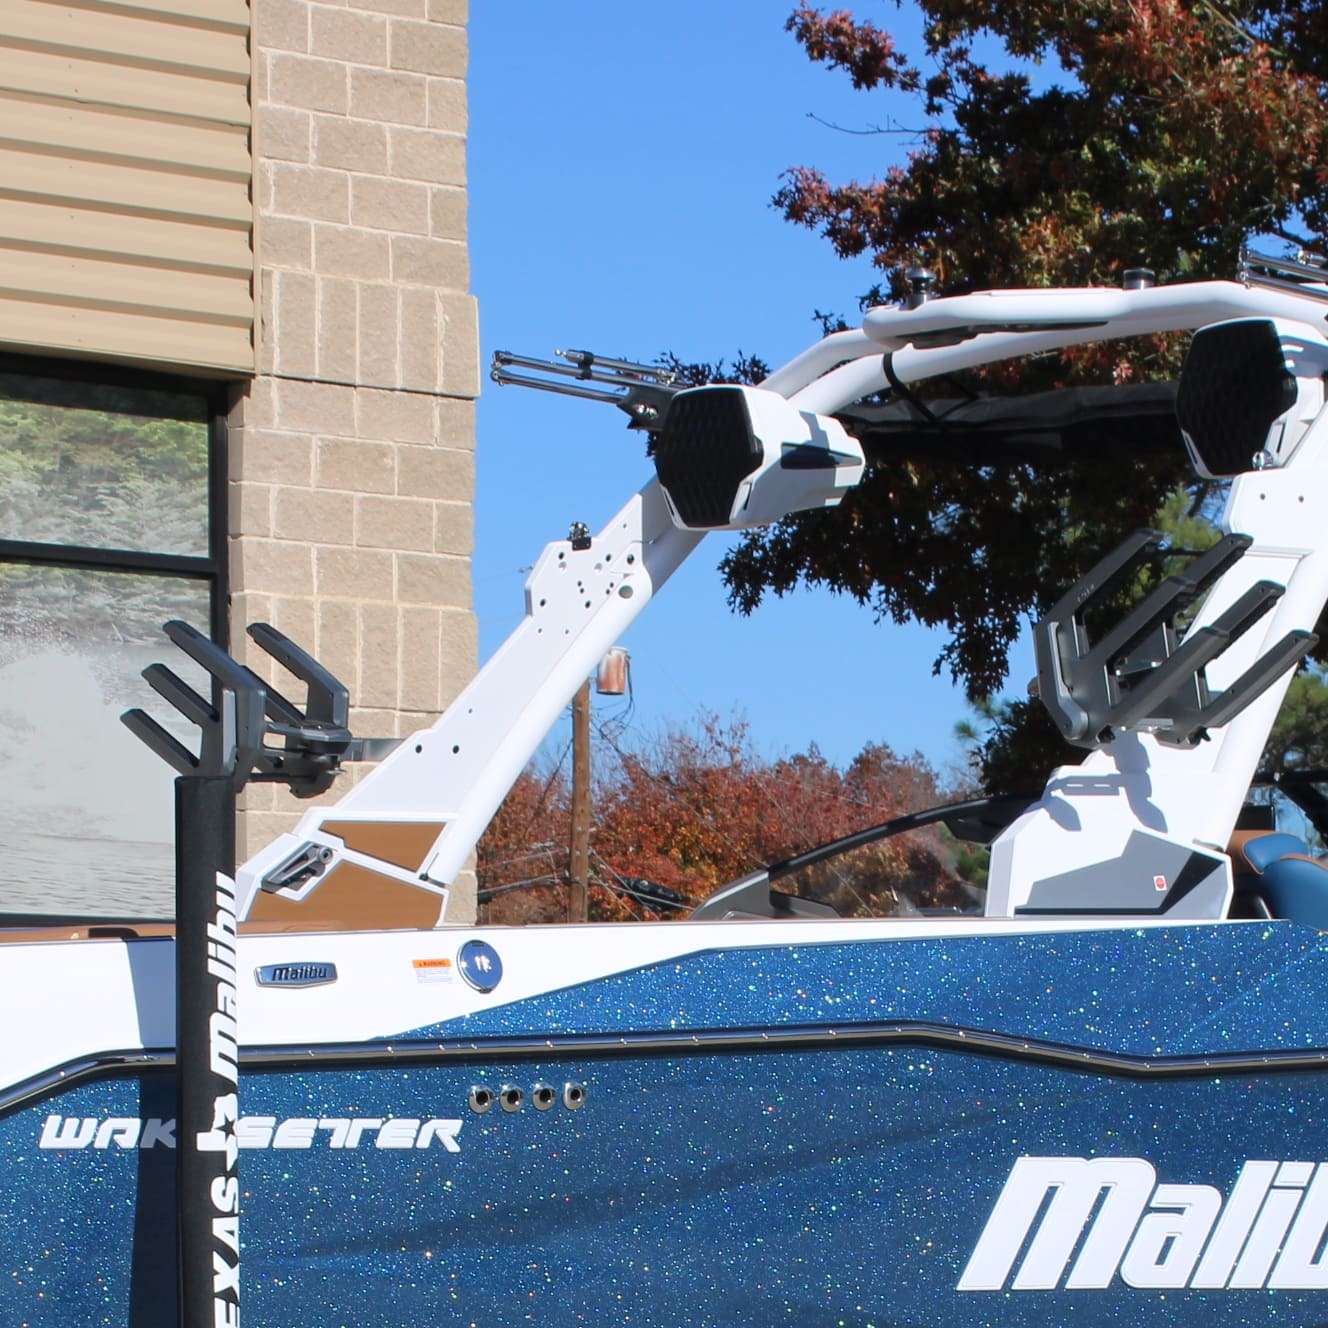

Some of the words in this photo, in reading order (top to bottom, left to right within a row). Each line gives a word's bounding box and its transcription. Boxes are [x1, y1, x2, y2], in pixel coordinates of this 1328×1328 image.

[207, 870, 239, 1086] Malibu
[271, 966, 328, 982] Malibu
[38, 1114, 465, 1154] WAKSETTER
